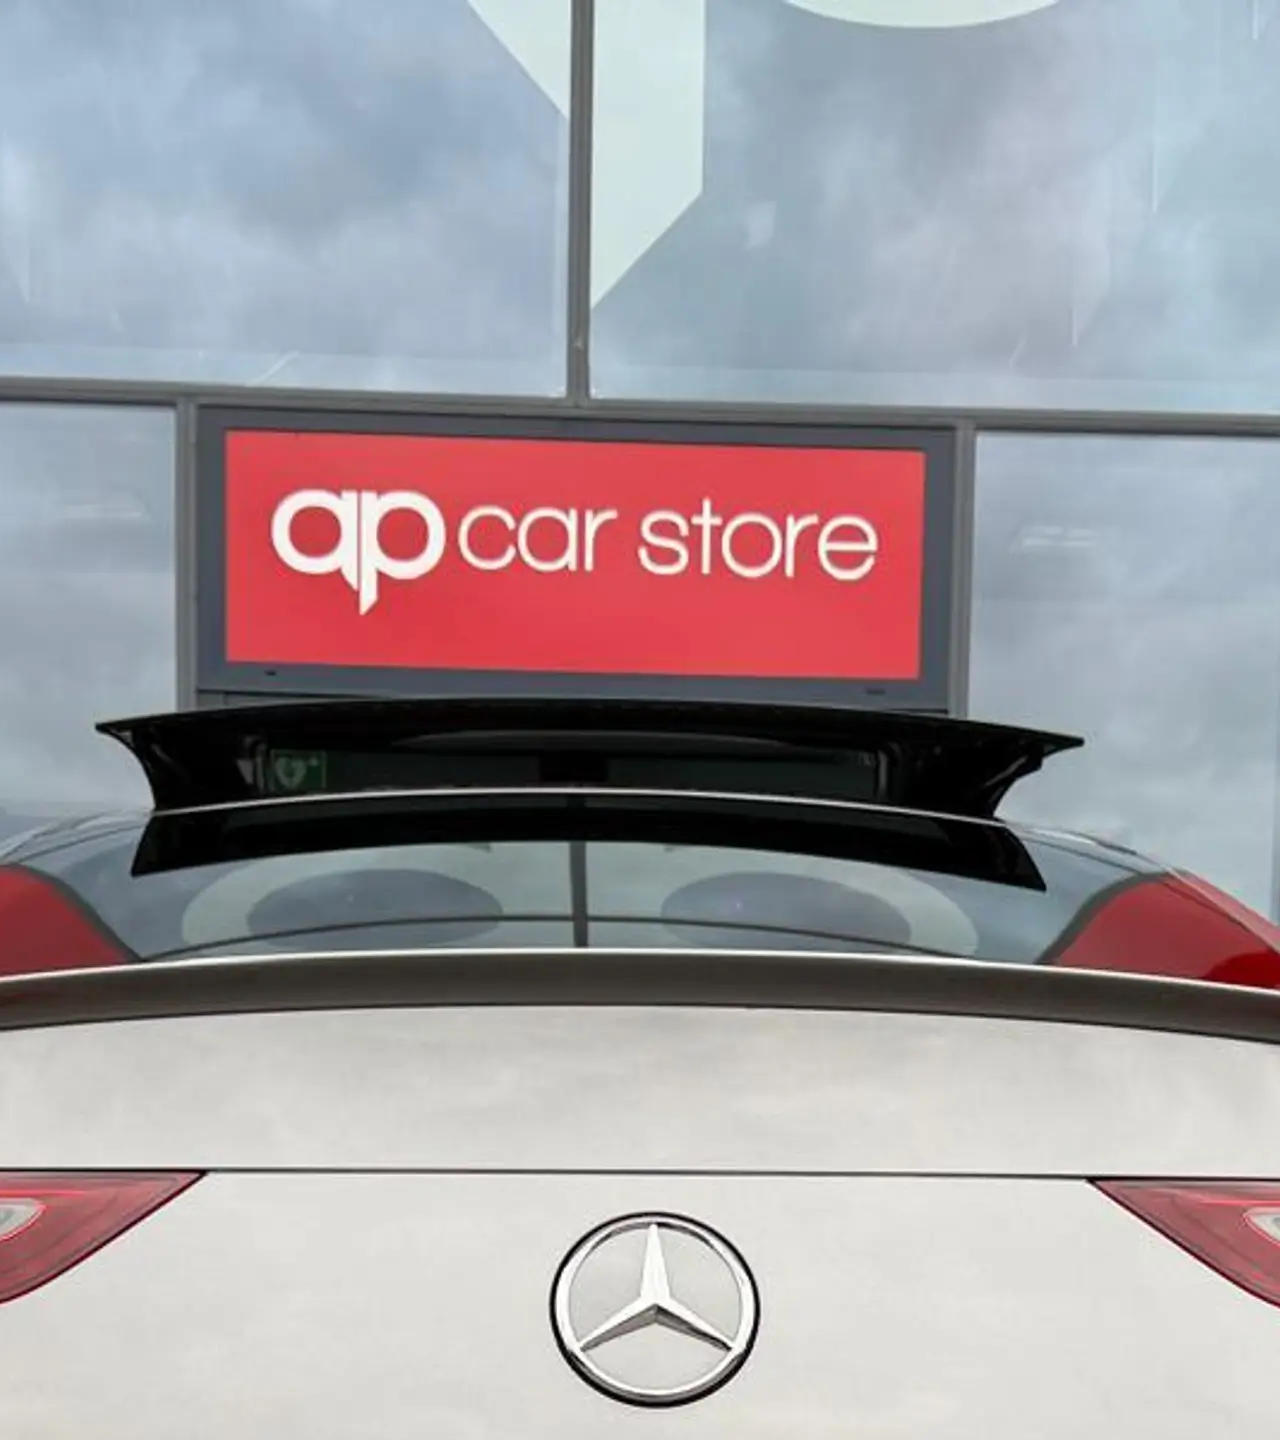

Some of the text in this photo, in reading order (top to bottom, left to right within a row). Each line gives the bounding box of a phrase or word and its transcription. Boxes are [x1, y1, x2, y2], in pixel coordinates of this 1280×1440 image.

[271, 489, 878, 615] ap car store
